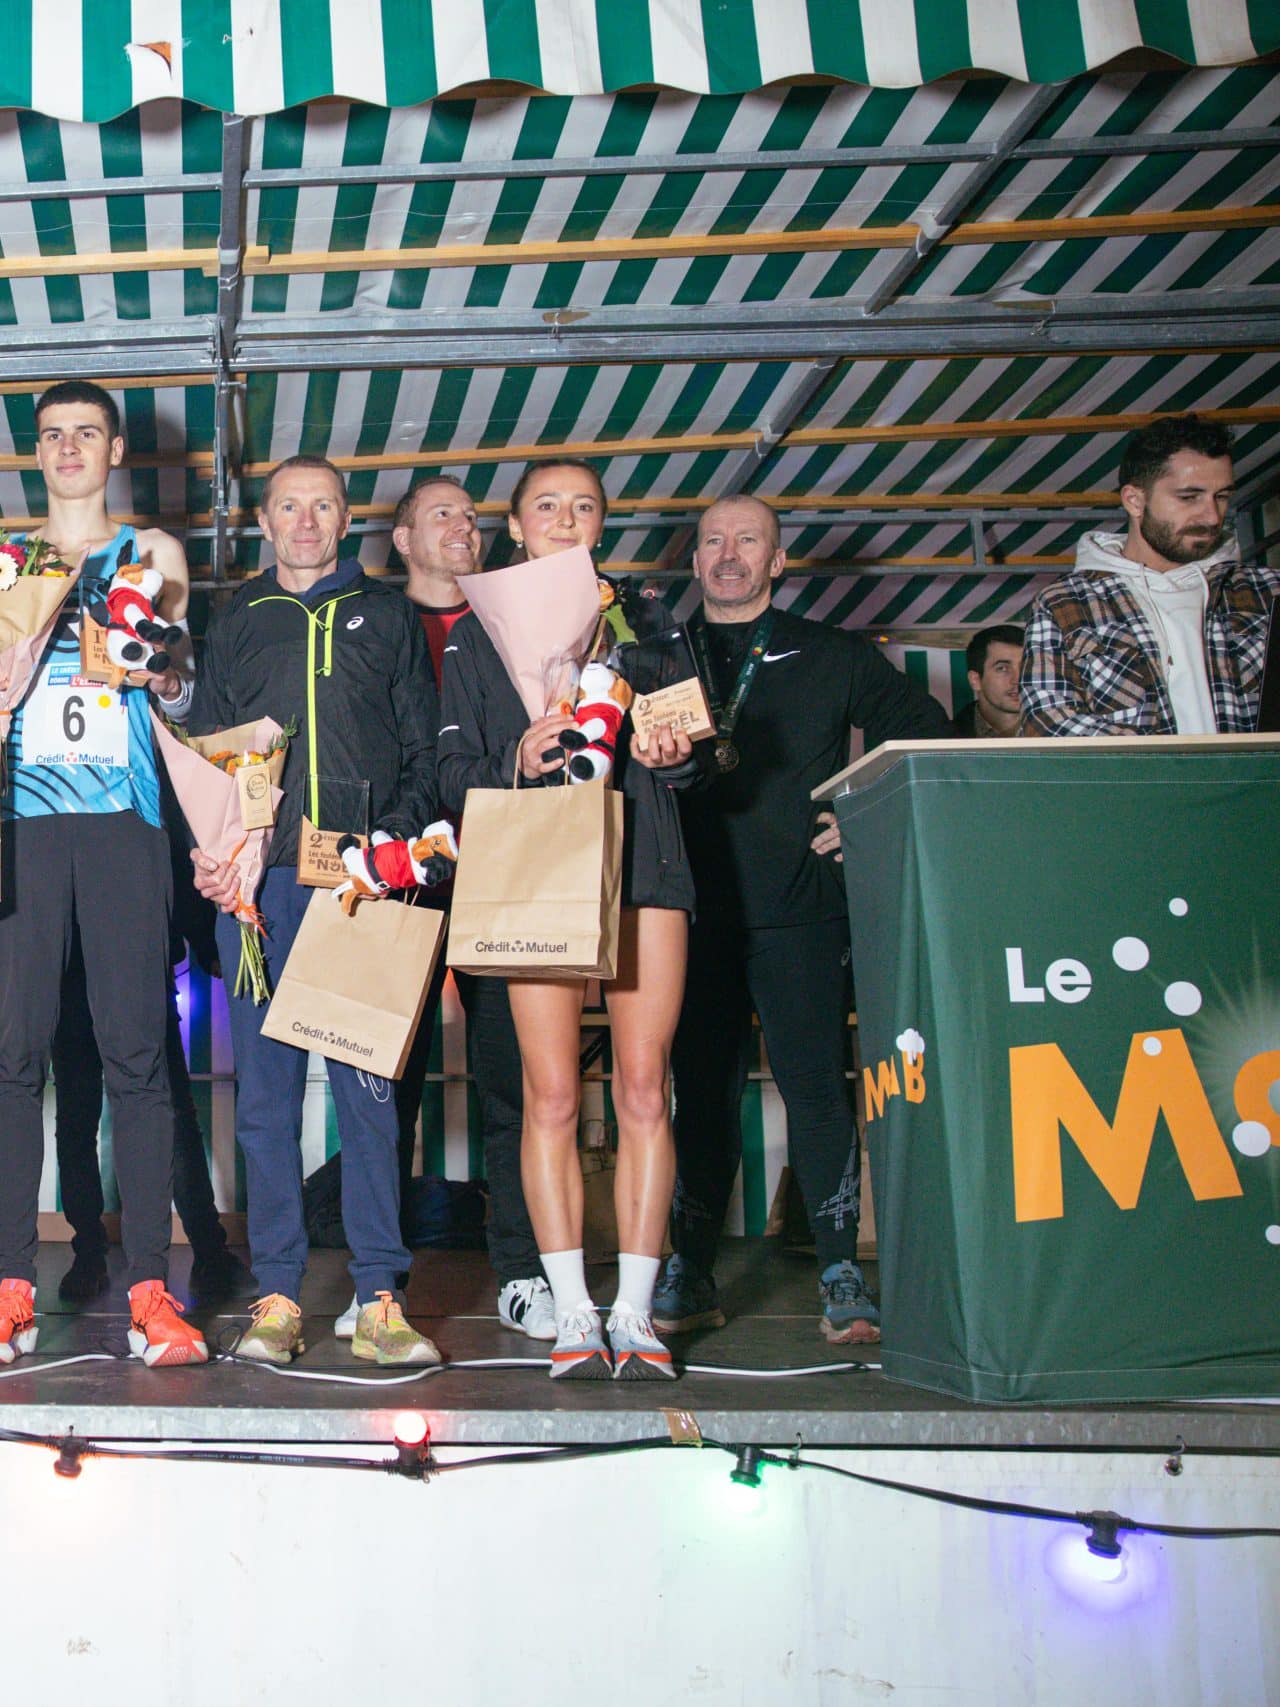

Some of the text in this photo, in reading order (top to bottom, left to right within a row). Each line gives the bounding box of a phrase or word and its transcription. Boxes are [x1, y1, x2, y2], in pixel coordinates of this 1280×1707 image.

[63, 695, 86, 742] 6
[36, 753, 114, 765] Crédit Mutuel
[475, 941, 568, 953] Crédit Mutuel
[1005, 947, 1092, 1003] Le
[292, 1021, 374, 1057] Crédit Mutuel
